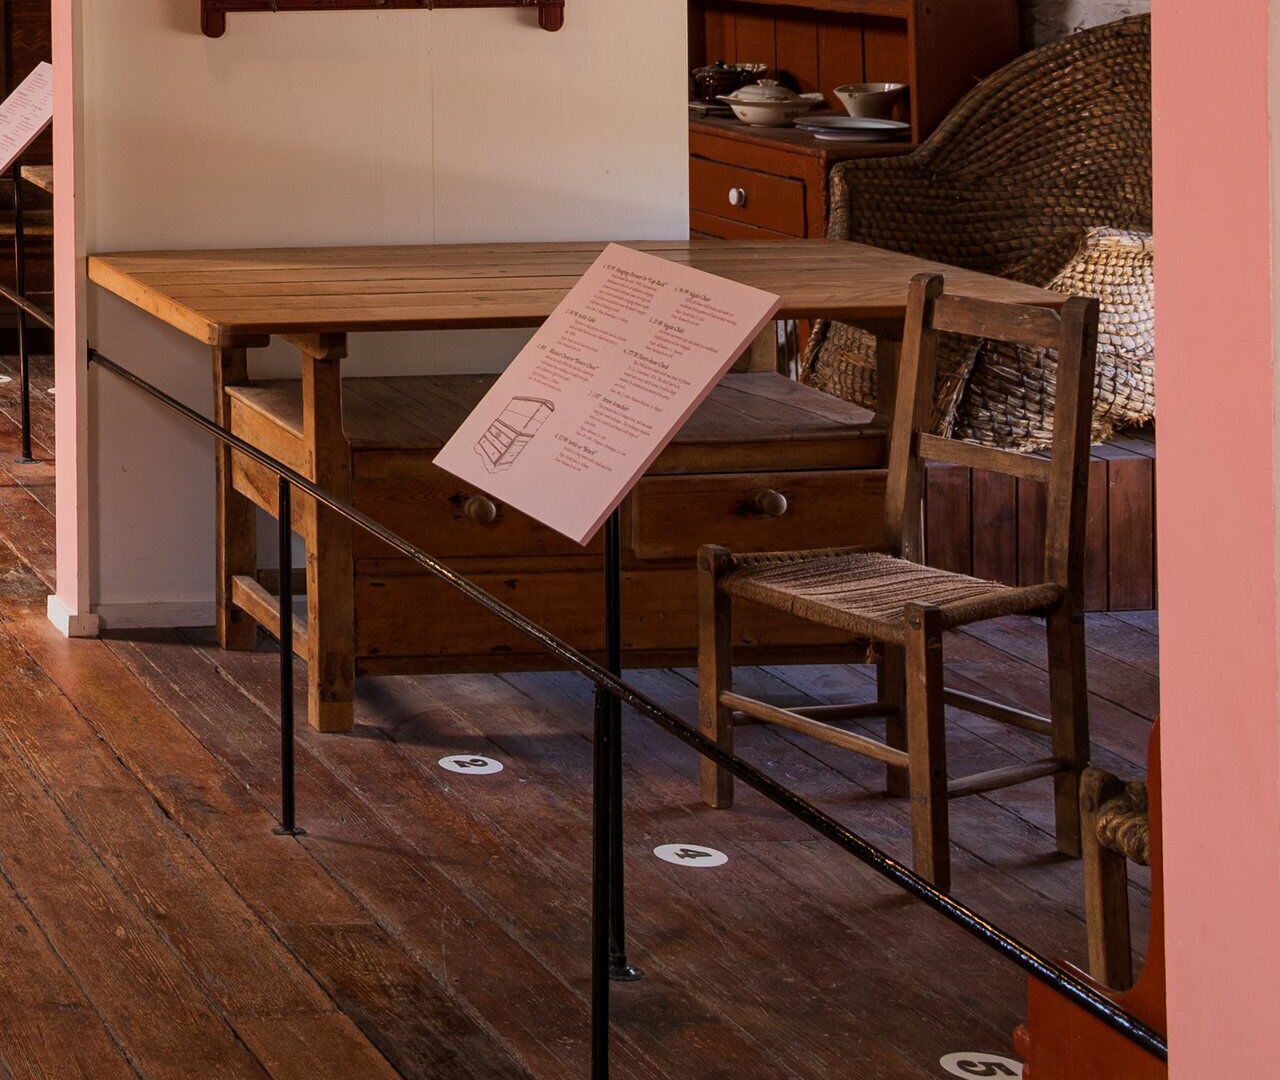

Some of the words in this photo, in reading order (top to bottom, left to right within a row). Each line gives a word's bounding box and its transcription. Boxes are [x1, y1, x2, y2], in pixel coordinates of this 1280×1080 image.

[454, 758, 489, 769] 2
[675, 848, 713, 860] 4
[956, 1059, 1019, 1077] 5
